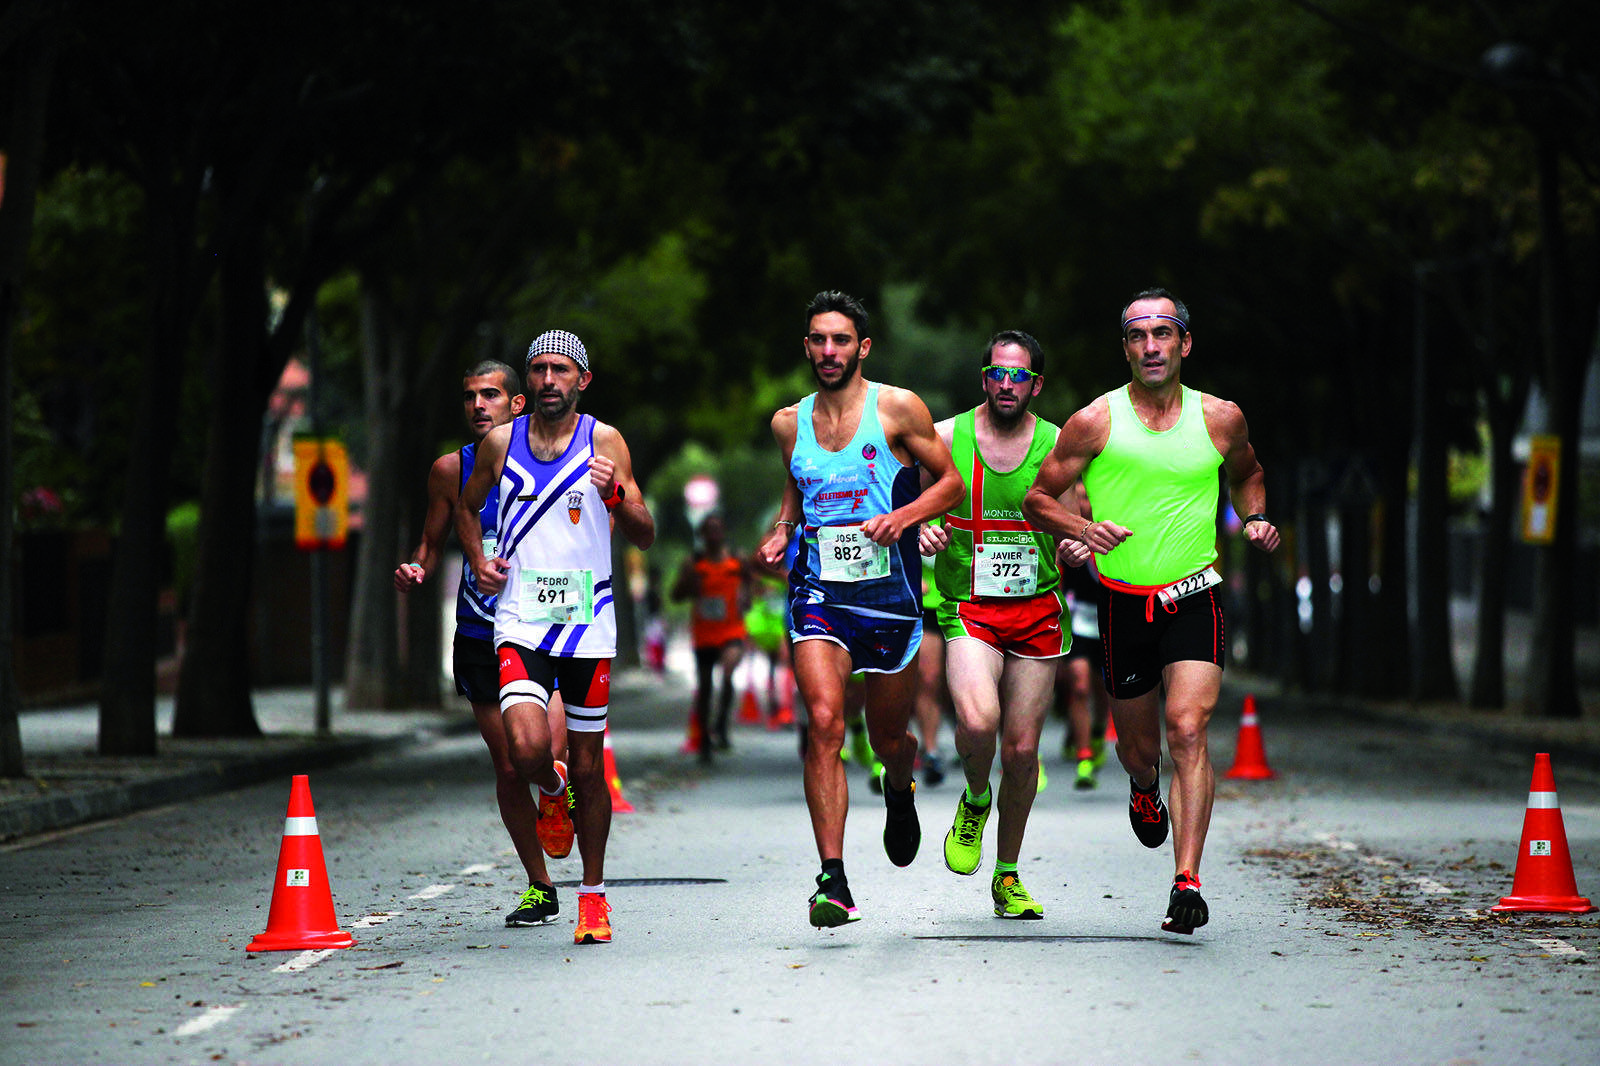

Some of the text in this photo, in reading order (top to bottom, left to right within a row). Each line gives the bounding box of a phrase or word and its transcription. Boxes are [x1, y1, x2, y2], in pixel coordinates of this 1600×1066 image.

[835, 533, 858, 543] JOSE
[834, 546, 862, 560] 882
[991, 552, 1022, 560] JAVIER
[992, 563, 1021, 577] 372
[536, 577, 569, 586] PEDRO
[1172, 573, 1210, 598] 1222
[538, 589, 565, 604] 691
